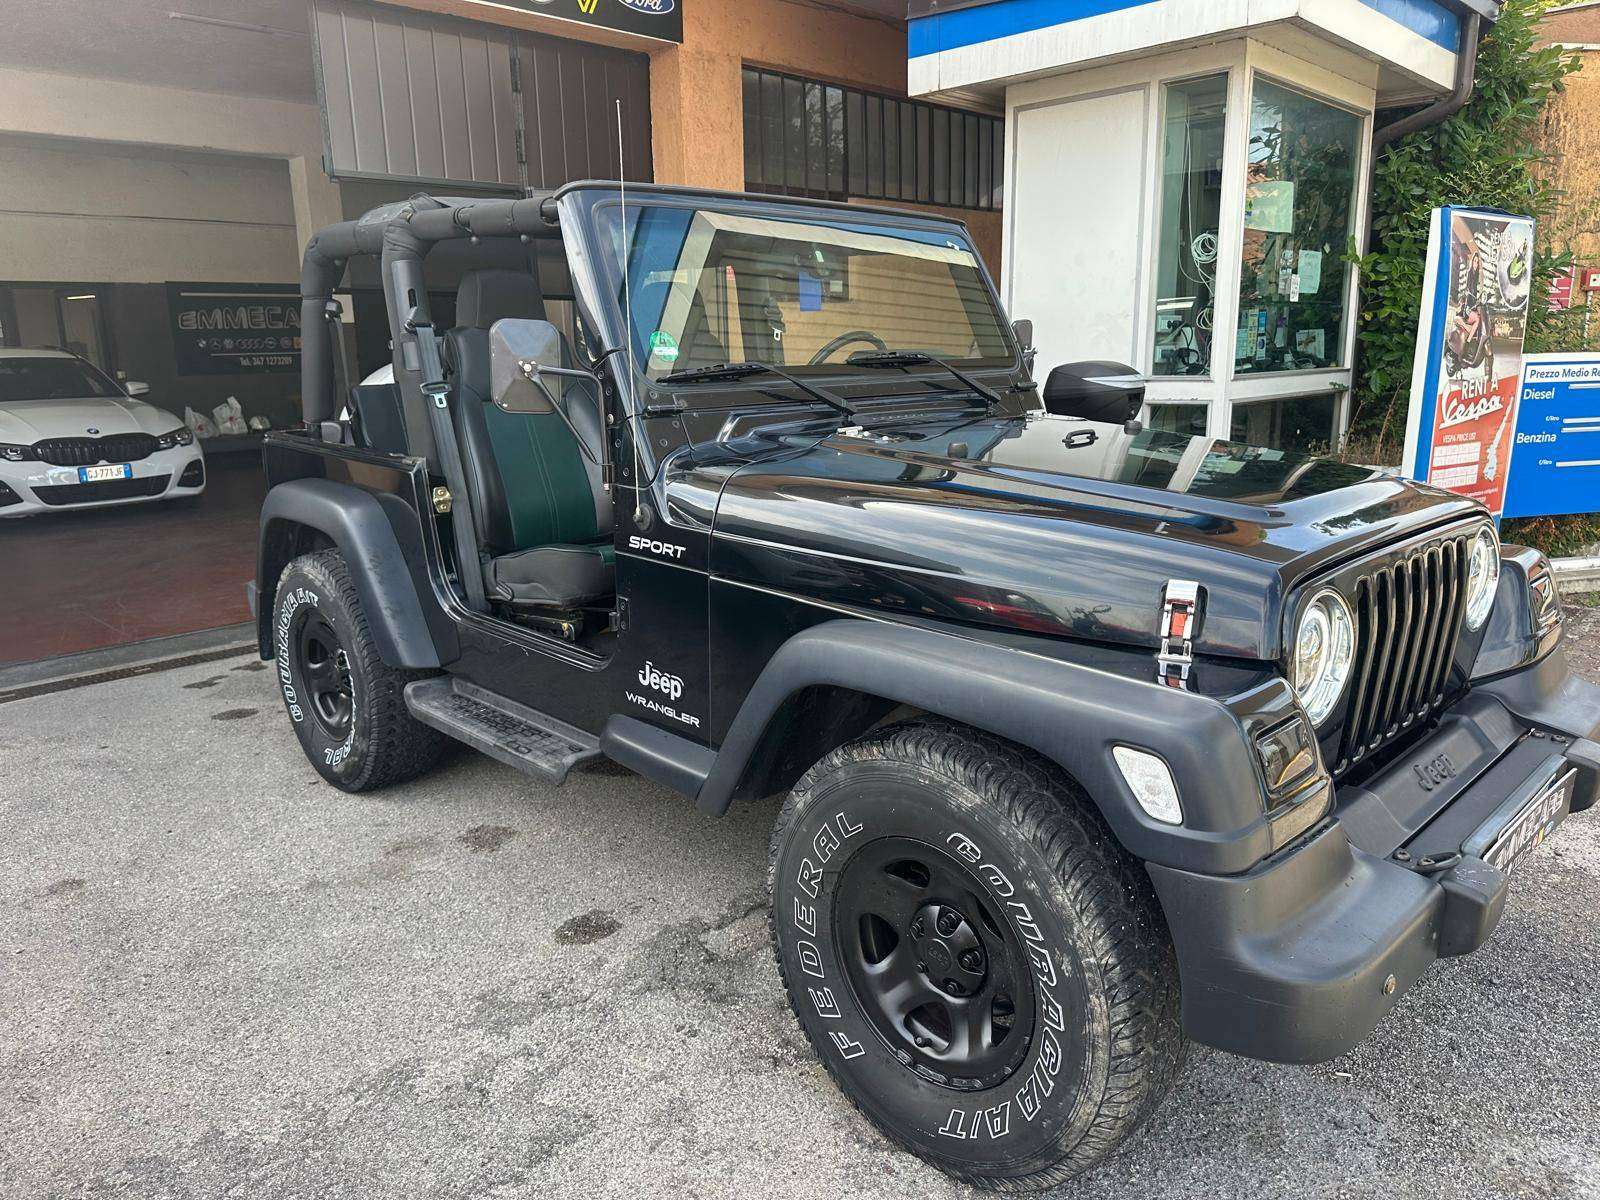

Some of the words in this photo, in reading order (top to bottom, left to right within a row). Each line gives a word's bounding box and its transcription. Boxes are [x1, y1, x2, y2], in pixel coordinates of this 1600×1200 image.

[624, 0, 663, 11] ord
[1462, 377, 1490, 400] RENT
[1490, 376, 1499, 392] A
[1530, 369, 1560, 379] Prezzo
[1562, 367, 1590, 378] Medio
[1523, 387, 1555, 400] Diesel
[1516, 431, 1557, 444] Benzina
[628, 535, 687, 559] SPORT
[638, 660, 685, 700] Jeep
[625, 690, 700, 728] WRANGLER
[1412, 753, 1457, 792] Jeep
[794, 812, 866, 1060] FEDERAL
[946, 832, 1065, 1122] COURAGIA
[938, 1100, 1012, 1140] A/T
